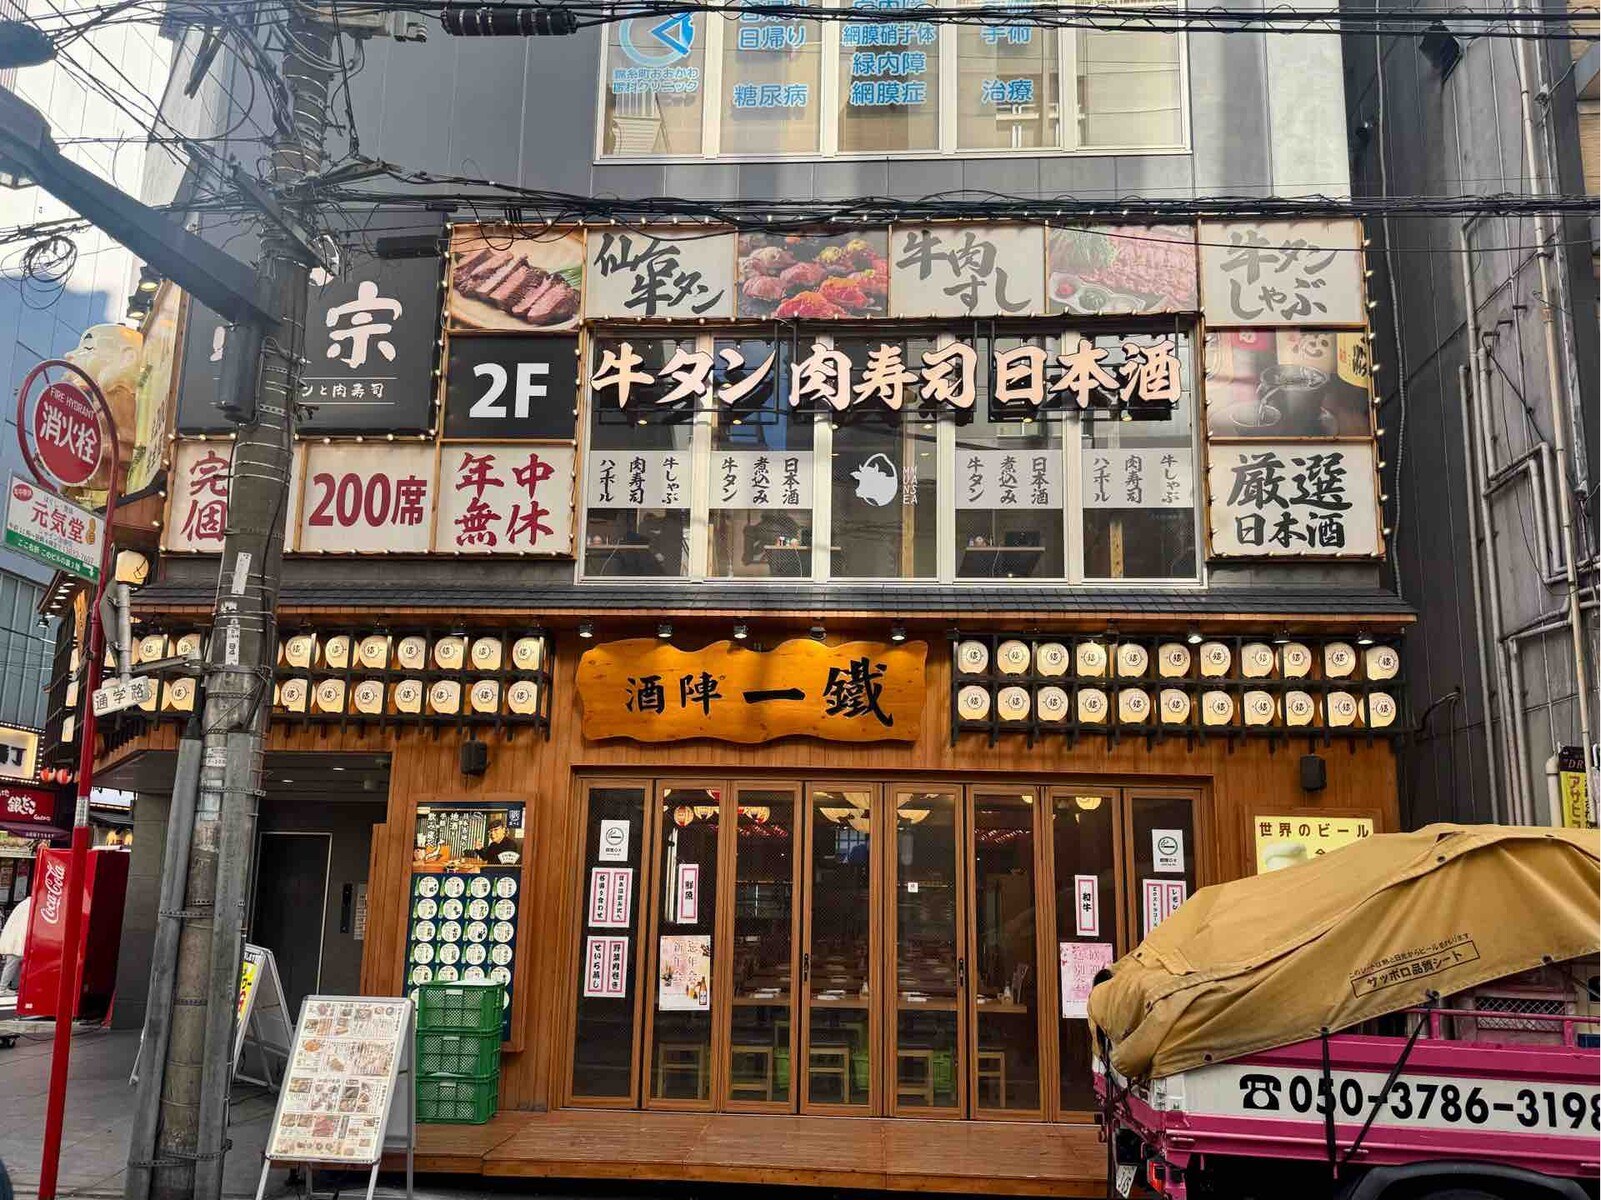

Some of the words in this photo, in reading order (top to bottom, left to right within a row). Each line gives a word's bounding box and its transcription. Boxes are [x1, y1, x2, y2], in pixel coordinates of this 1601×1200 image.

[740, 27, 806, 49] 日帰り
[843, 25, 936, 46] 網膜硝子体
[853, 53, 927, 75] 緑内障
[735, 84, 808, 107] 糖尿病
[852, 81, 927, 105] 網膜症
[982, 79, 1034, 102] 治療
[594, 232, 681, 278] 仙台
[895, 229, 998, 280] 牛肉
[1220, 230, 1340, 284] 牛タン
[624, 270, 725, 317] 牛タン
[943, 266, 1033, 314] すし
[1230, 276, 1328, 321] しゃぶ
[325, 280, 402, 369] 宗
[469, 363, 550, 419] 2F
[589, 341, 777, 409] 牛タン
[789, 342, 978, 411] 肉寿司
[994, 338, 1182, 409] 日本酒
[51, 386, 65, 402] FIRE
[65, 394, 96, 422] HYDRANT
[39, 400, 97, 465] 消火栓
[455, 451, 555, 501] 年中
[599, 458, 614, 503] ハイボール
[628, 456, 647, 505] 肉寿司
[661, 456, 680, 505] 牛しゃぶ
[719, 456, 739, 502] 牛タン
[750, 455, 770, 505] 煮込み
[782, 456, 800, 506] 日本酒
[967, 456, 985, 502] 牛タン
[998, 455, 1018, 505] 煮込み
[1031, 456, 1050, 506] 日本酒
[1092, 456, 1111, 503] ハイボール
[1123, 455, 1143, 505] 肉寿司
[1160, 454, 1180, 504] 牛しゃぶ
[1227, 451, 1353, 511] 厳選
[31, 501, 85, 544] 元気堂
[308, 472, 428, 528] 200席
[454, 497, 555, 547] 無休
[1234, 510, 1346, 549] 日本酒
[93, 680, 147, 710] 通学路
[626, 672, 724, 717] 酒陣
[1568, 759, 1586, 769] DR
[1259, 822, 1369, 838] 世界のビール
[1366, 950, 1463, 988] サッポロ品質シート
